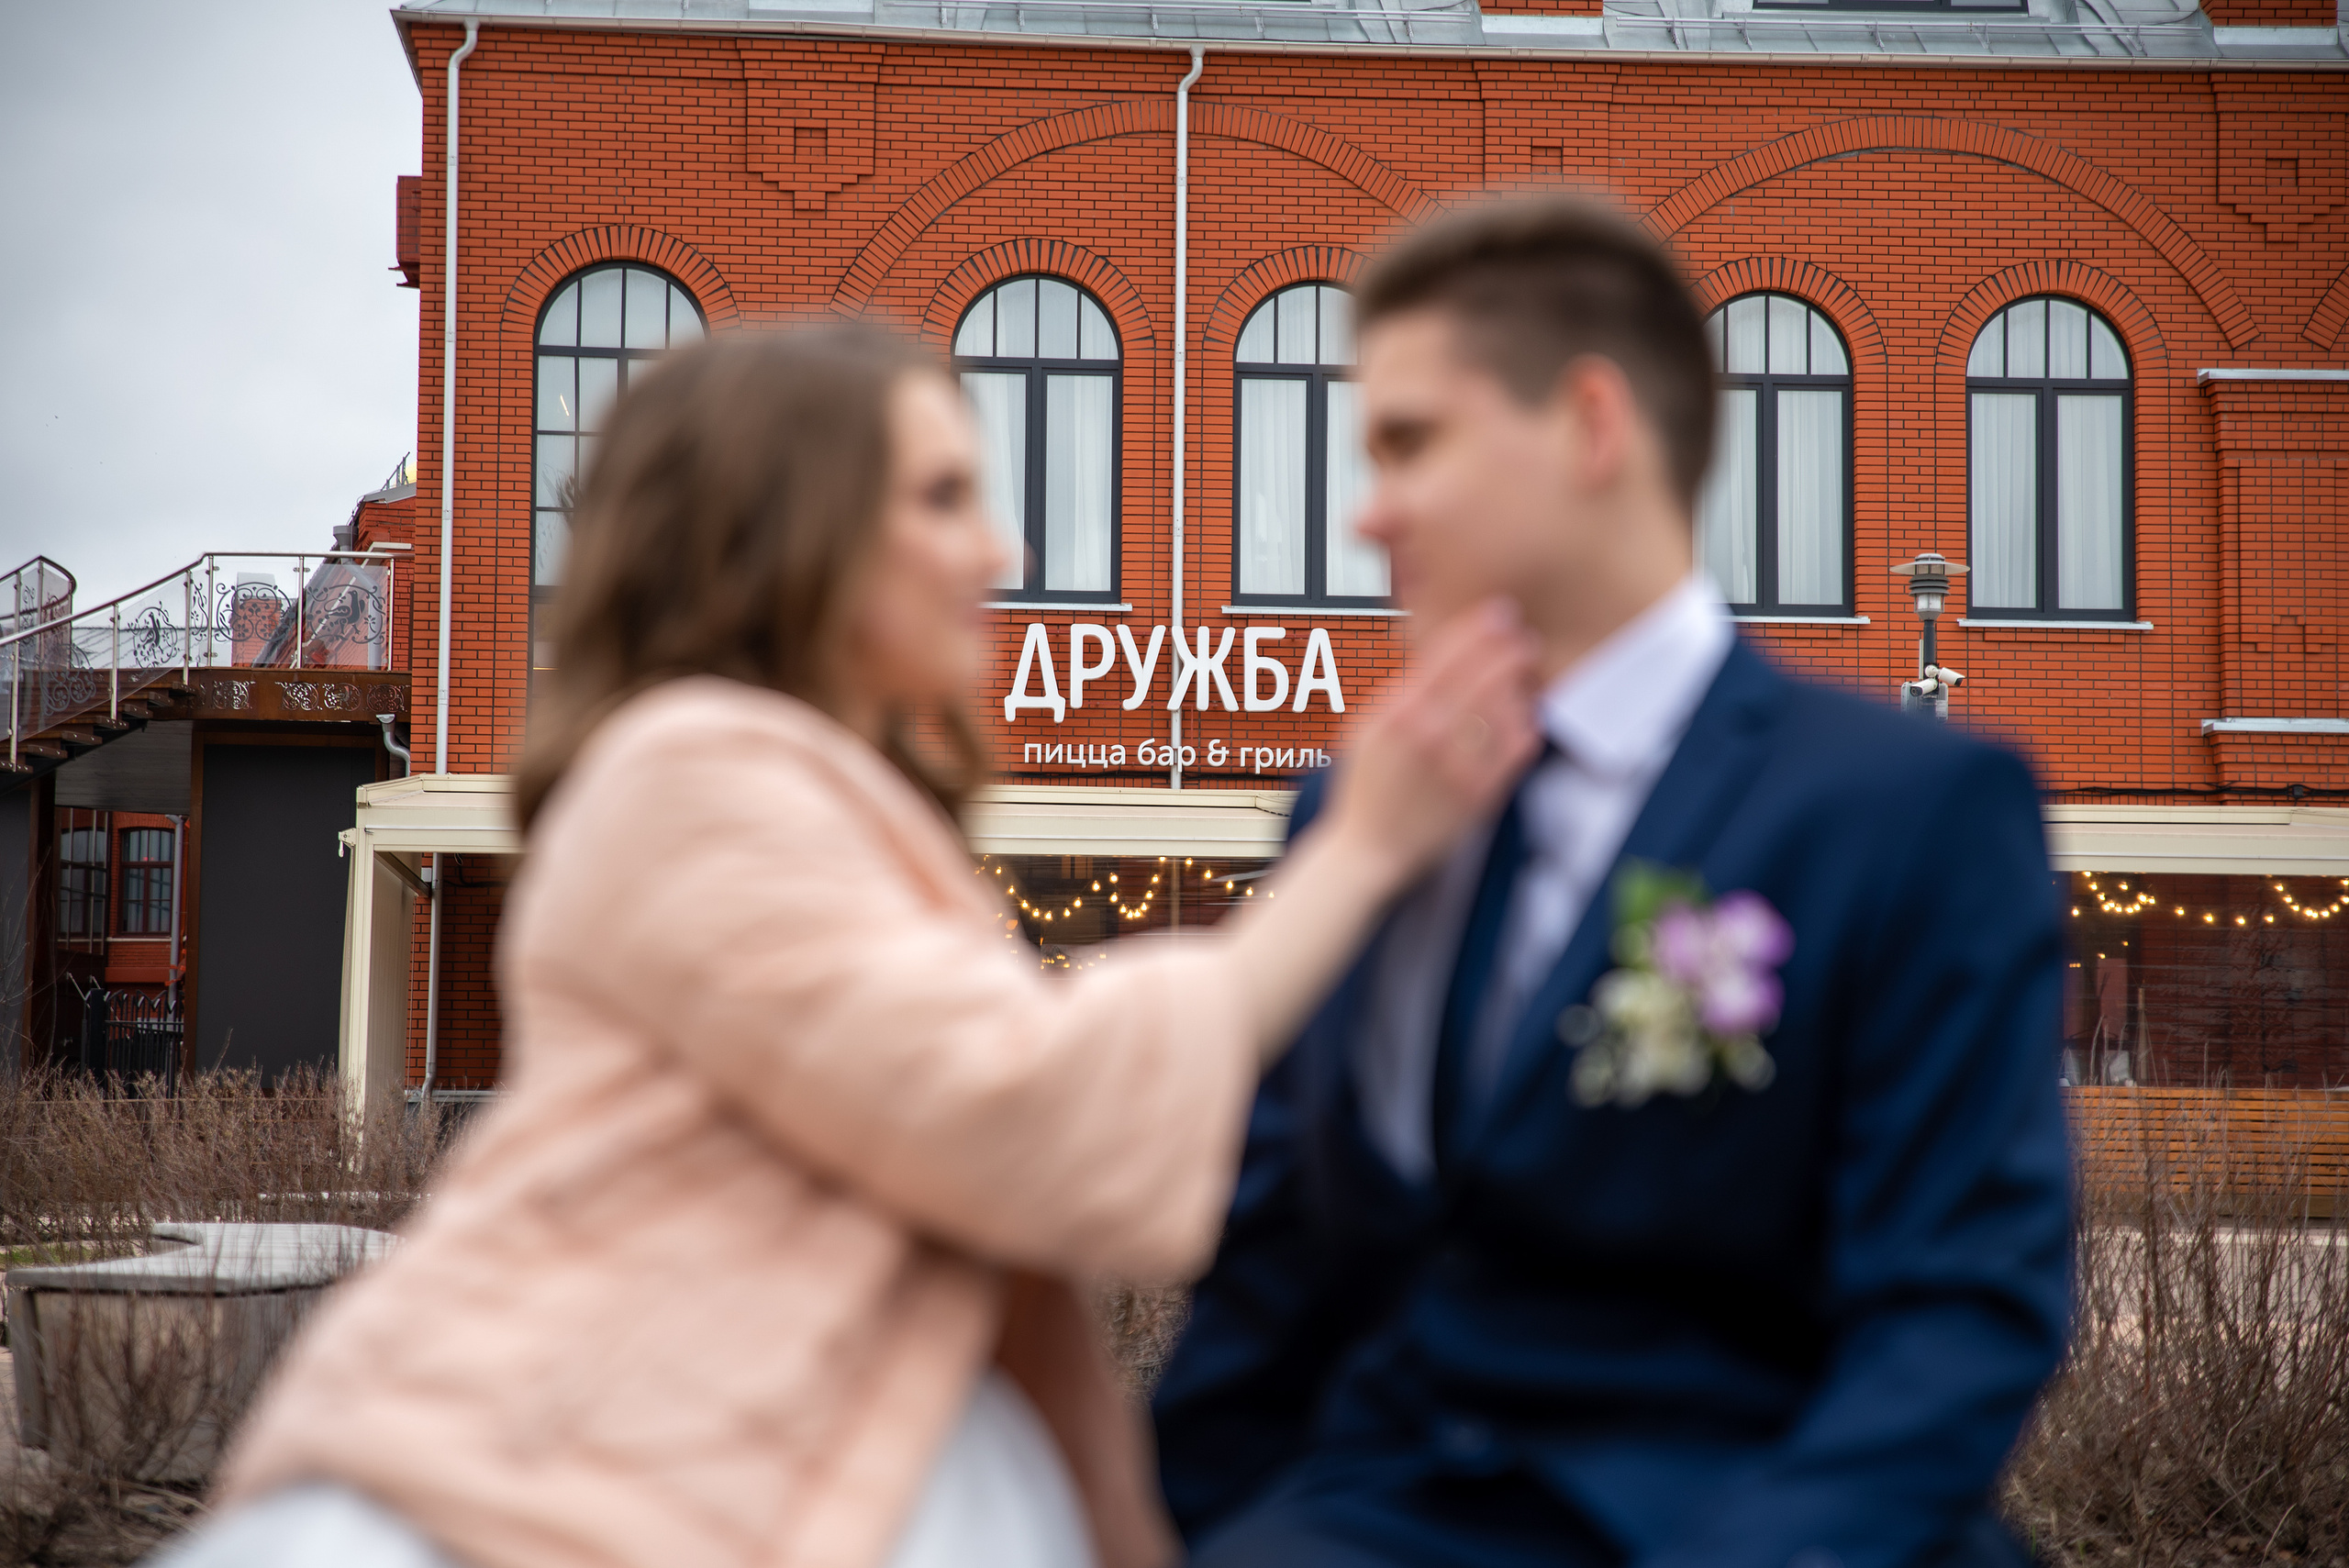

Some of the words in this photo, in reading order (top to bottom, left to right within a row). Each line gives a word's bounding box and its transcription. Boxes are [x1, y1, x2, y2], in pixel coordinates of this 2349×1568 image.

[1004, 623, 1346, 723] ДРУЖБА
[1023, 742, 1126, 769] пицца
[1137, 738, 1197, 773] бар
[1207, 739, 1230, 767] &
[1240, 745, 1332, 774] гриль
